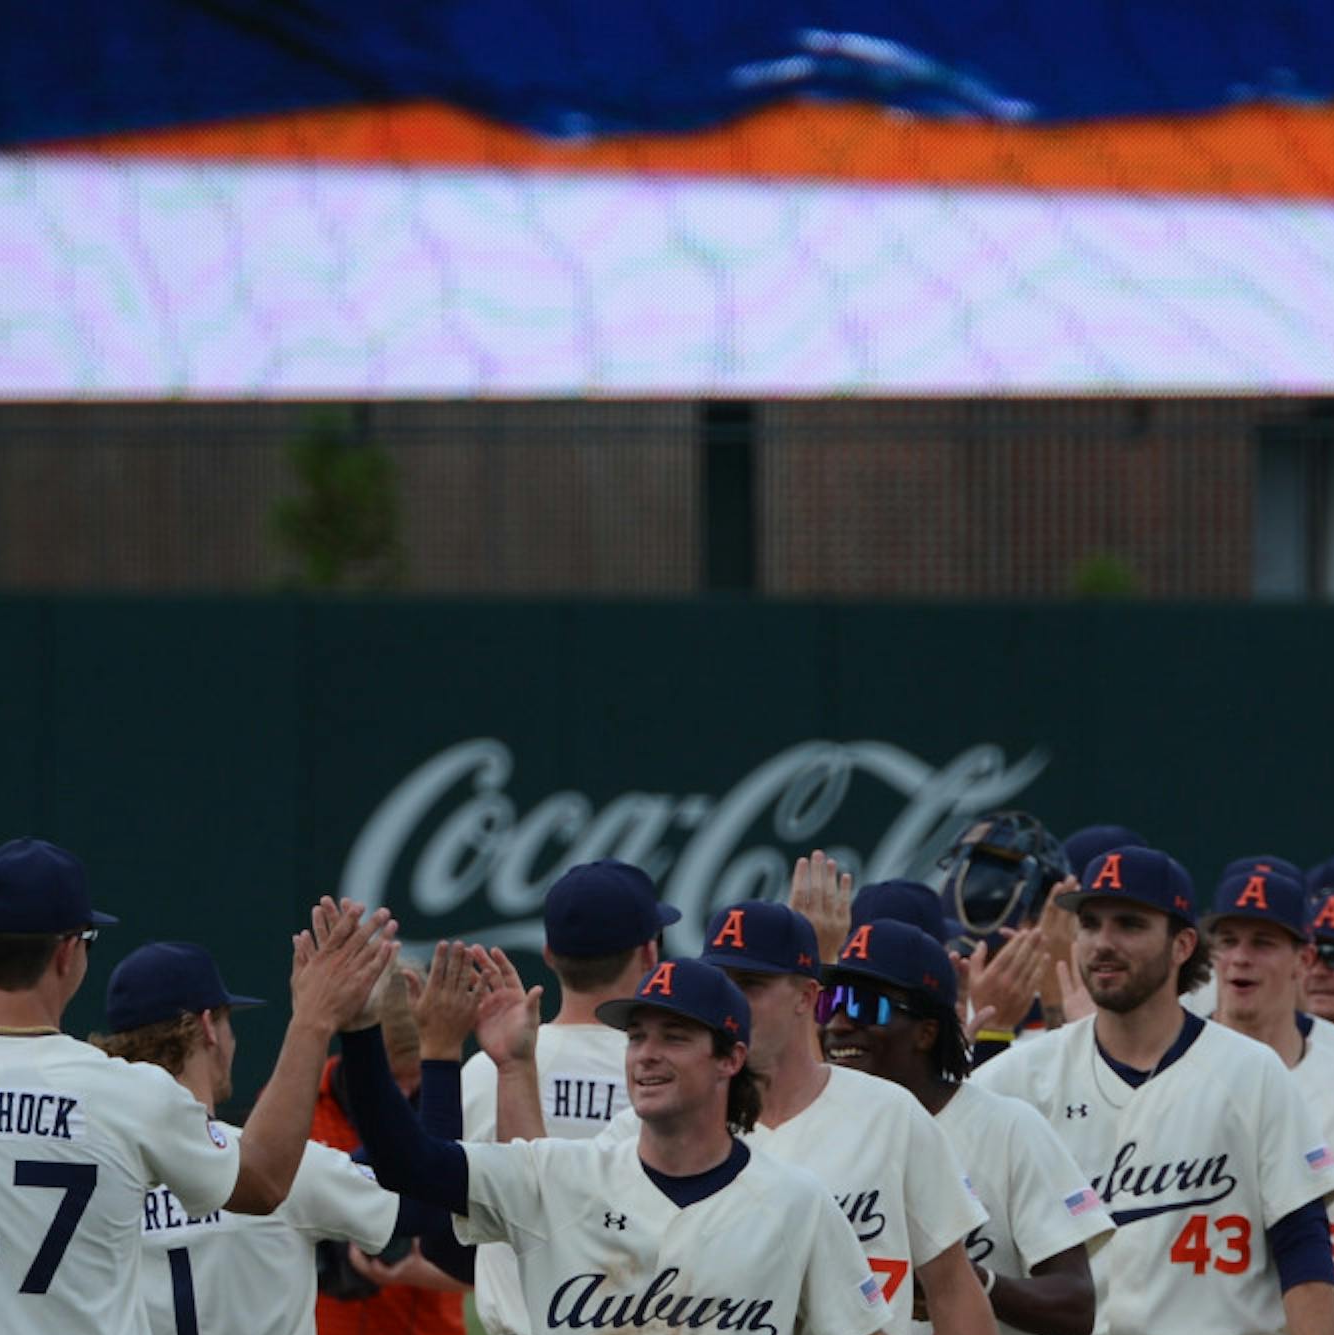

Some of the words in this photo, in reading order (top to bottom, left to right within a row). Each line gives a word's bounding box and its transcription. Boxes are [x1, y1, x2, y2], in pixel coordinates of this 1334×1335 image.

[335, 737, 1052, 958] Coca-Col
[1091, 853, 1122, 890] A
[1235, 875, 1268, 910] A
[712, 910, 746, 948] A
[841, 924, 874, 960] A
[641, 962, 676, 996] A
[1170, 1214, 1252, 1275] 43
